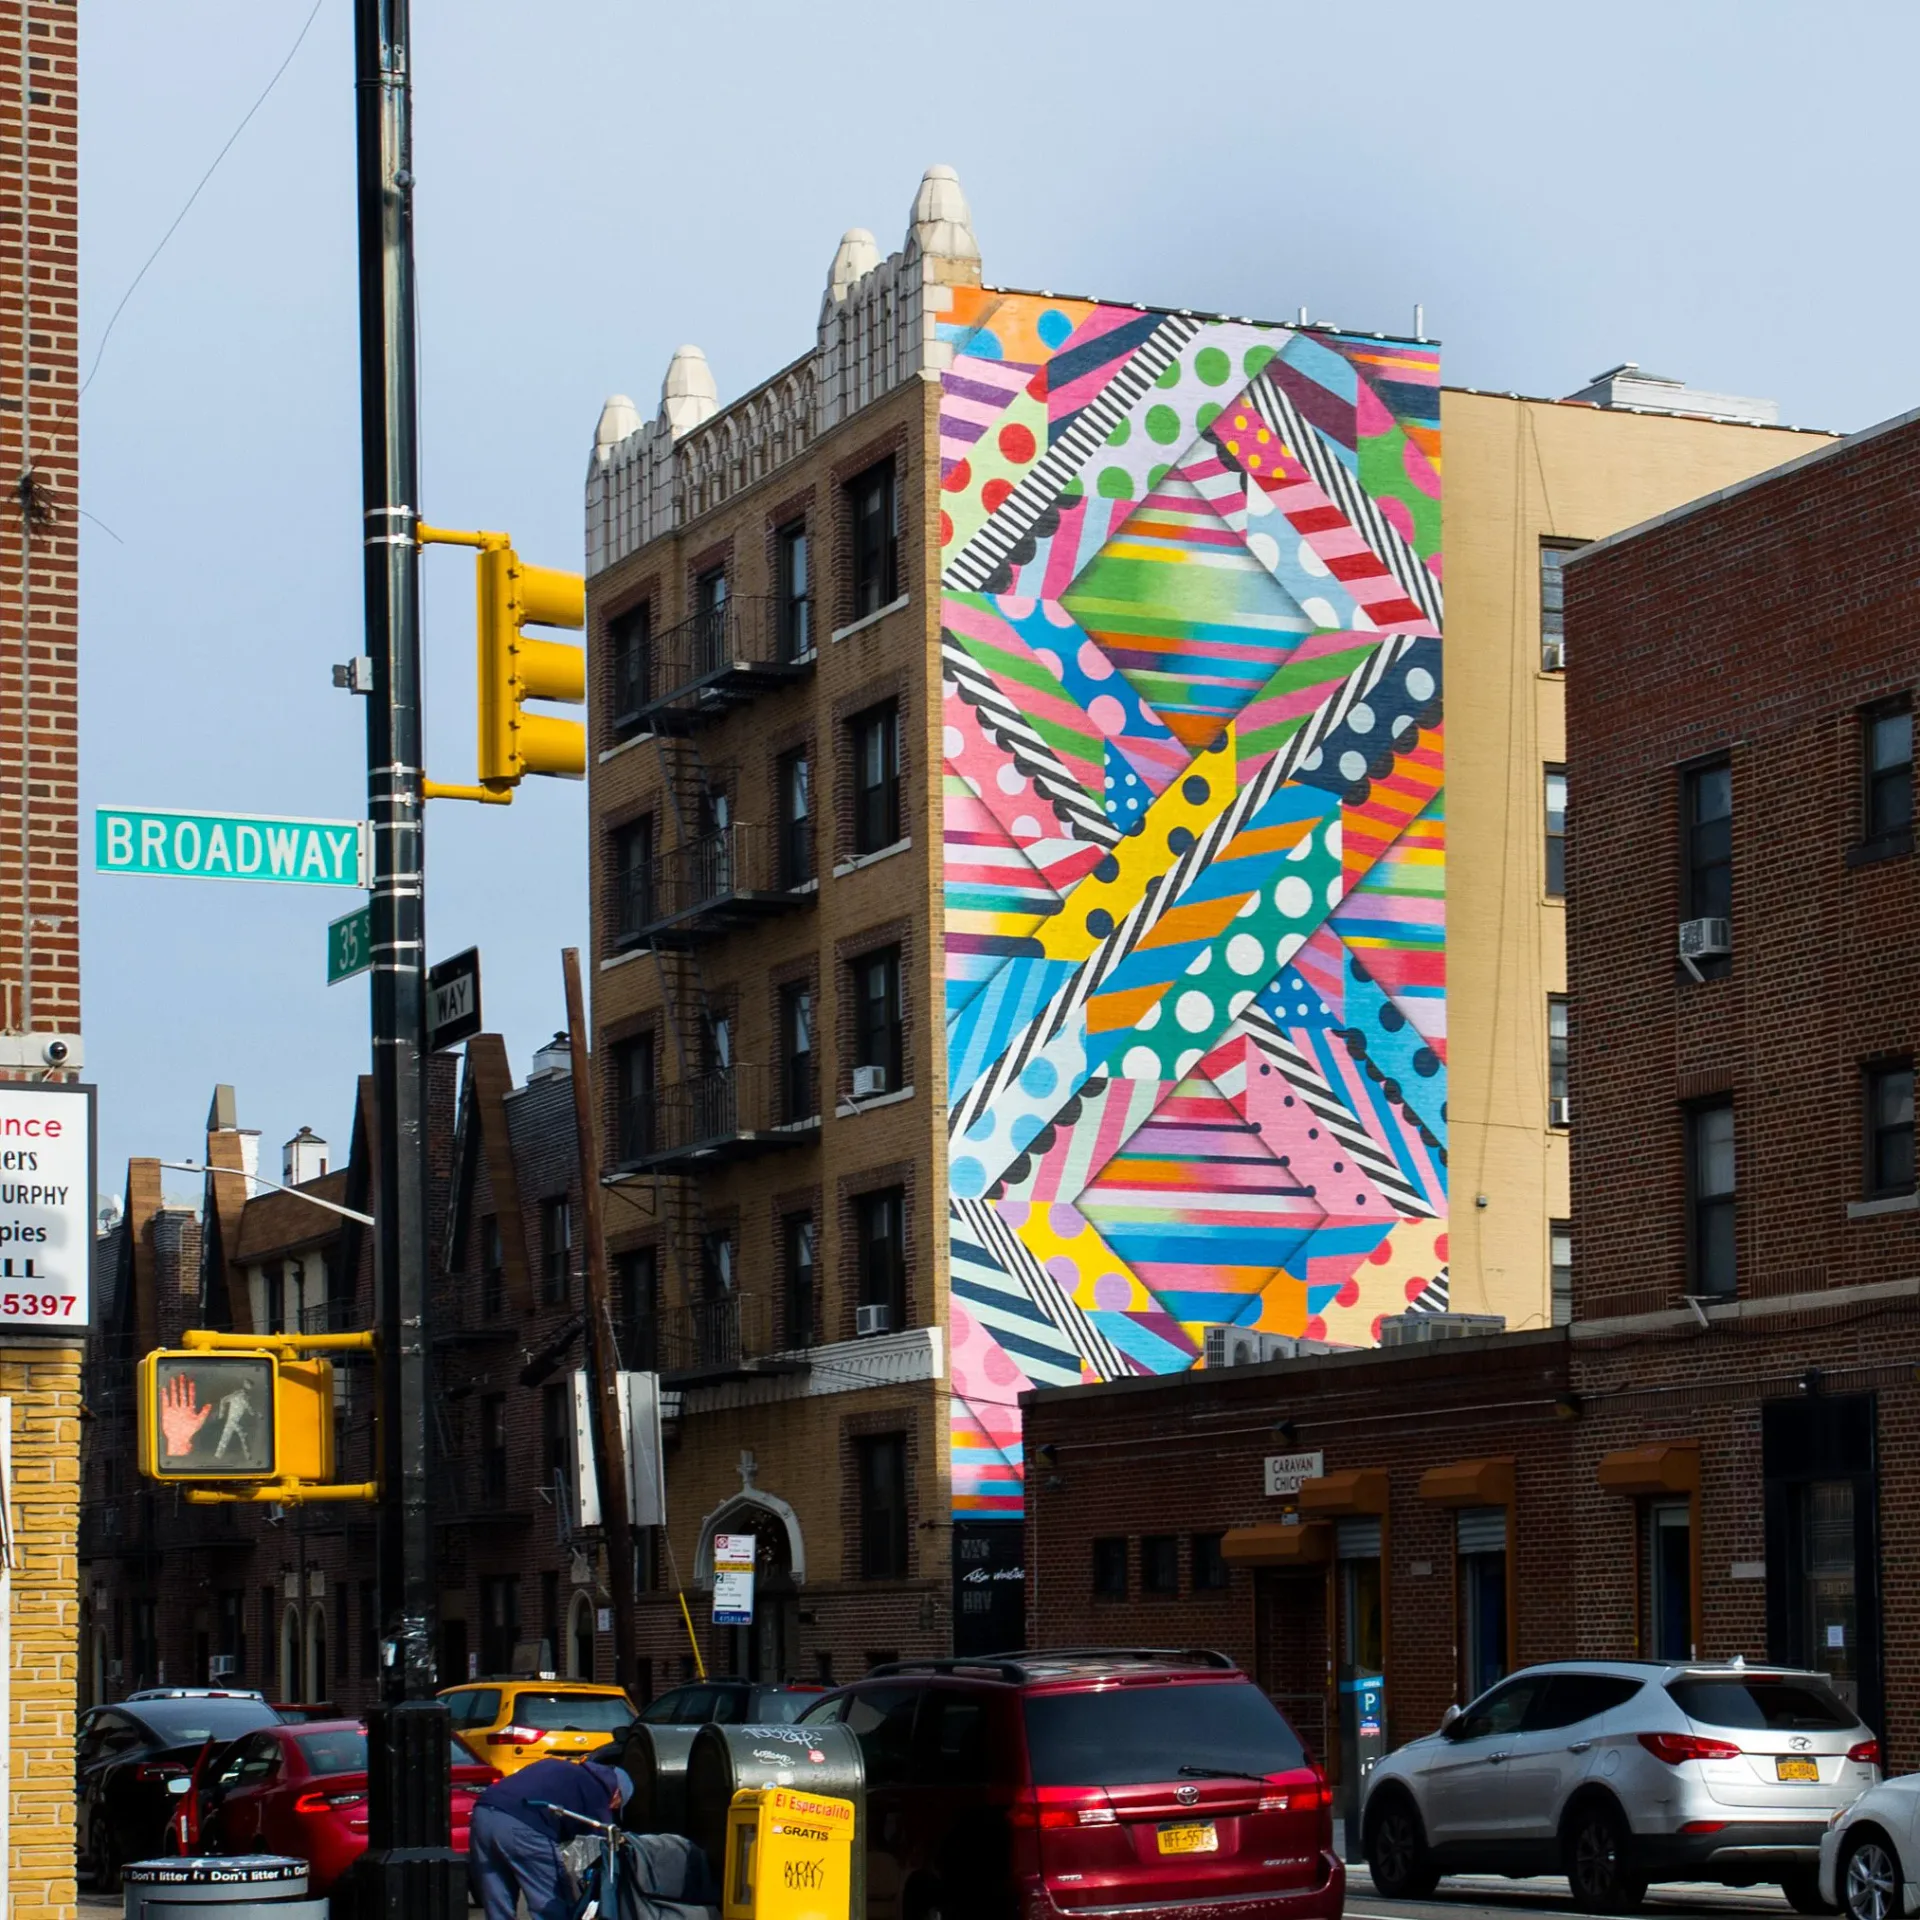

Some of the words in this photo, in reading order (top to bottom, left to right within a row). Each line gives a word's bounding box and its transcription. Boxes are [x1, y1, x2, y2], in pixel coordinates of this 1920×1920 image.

[106, 816, 352, 879] BROADWAY
[339, 920, 358, 971] 35
[436, 979, 467, 1023] WAY
[0, 1118, 62, 1138] nce
[0, 1150, 38, 1171] ers
[0, 1258, 45, 1279] LL
[1272, 1456, 1314, 1474] CARAVAN
[1274, 1474, 1313, 1492] CHICK
[1364, 1693, 1376, 1712] P
[775, 1793, 786, 1807] El
[789, 1796, 850, 1821] Especialito
[783, 1825, 829, 1841] GRATIS
[131, 1870, 155, 1881] Don't
[159, 1870, 189, 1881] litter
[211, 1870, 247, 1881] Don't
[251, 1868, 279, 1881] litter
